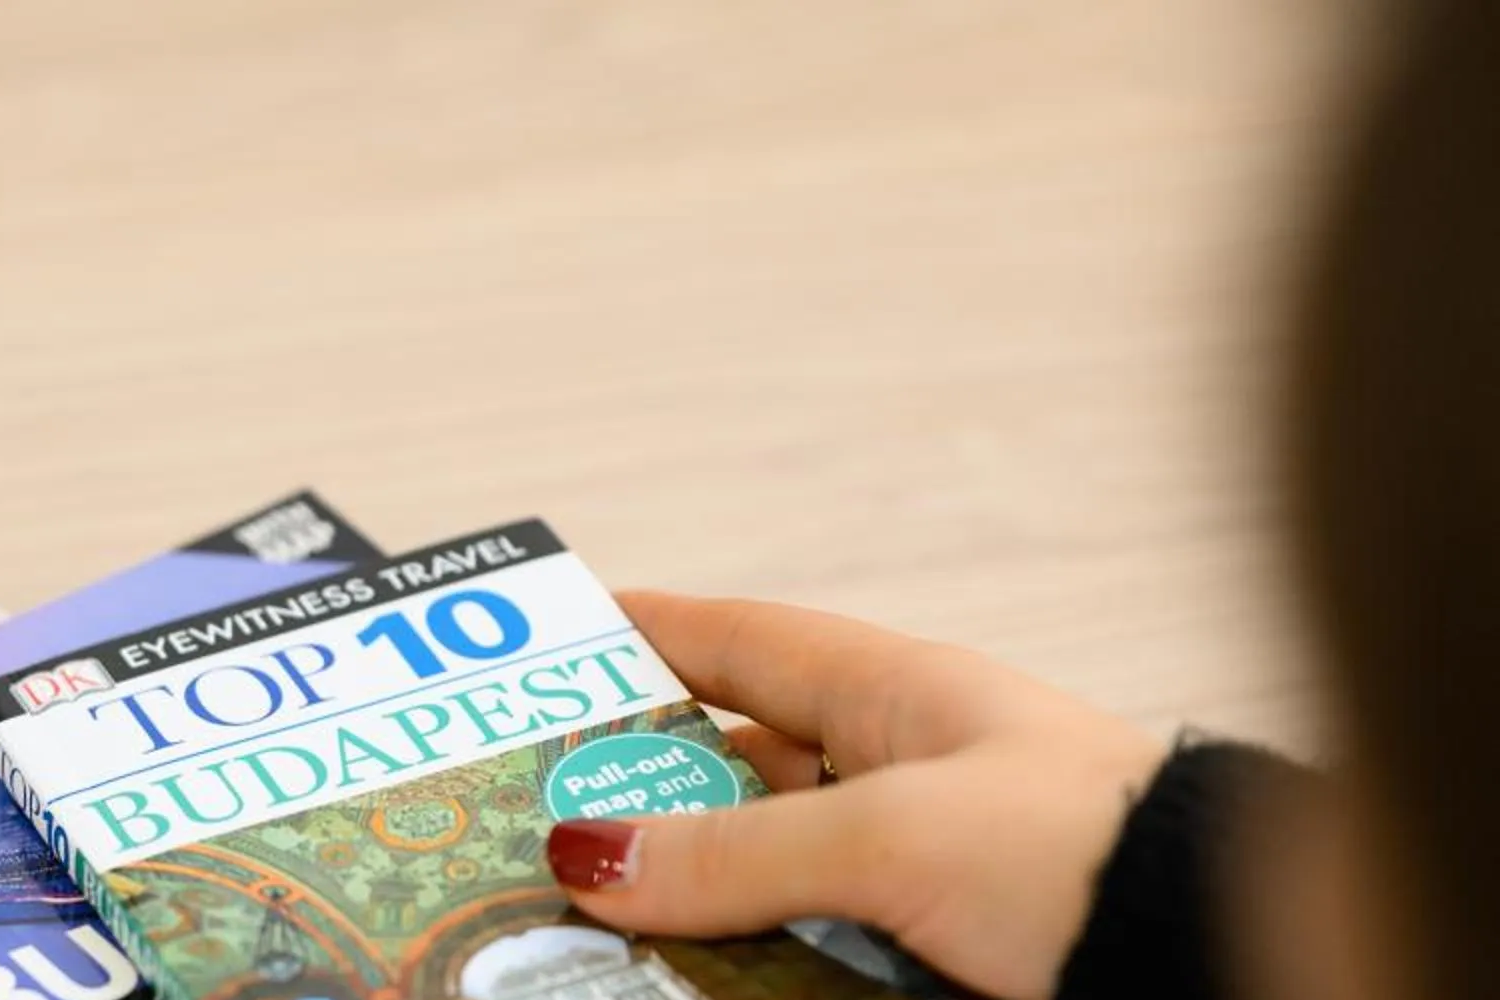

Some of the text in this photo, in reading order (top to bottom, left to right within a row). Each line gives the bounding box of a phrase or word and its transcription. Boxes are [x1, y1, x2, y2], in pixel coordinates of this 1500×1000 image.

[118, 534, 529, 669] EYEWITNESS TRAVEL
[19, 667, 102, 706] DK
[86, 587, 532, 755] TOP 10
[80, 643, 654, 854] BUDAPEST
[563, 745, 692, 797] Pull-out
[654, 764, 711, 798] and
